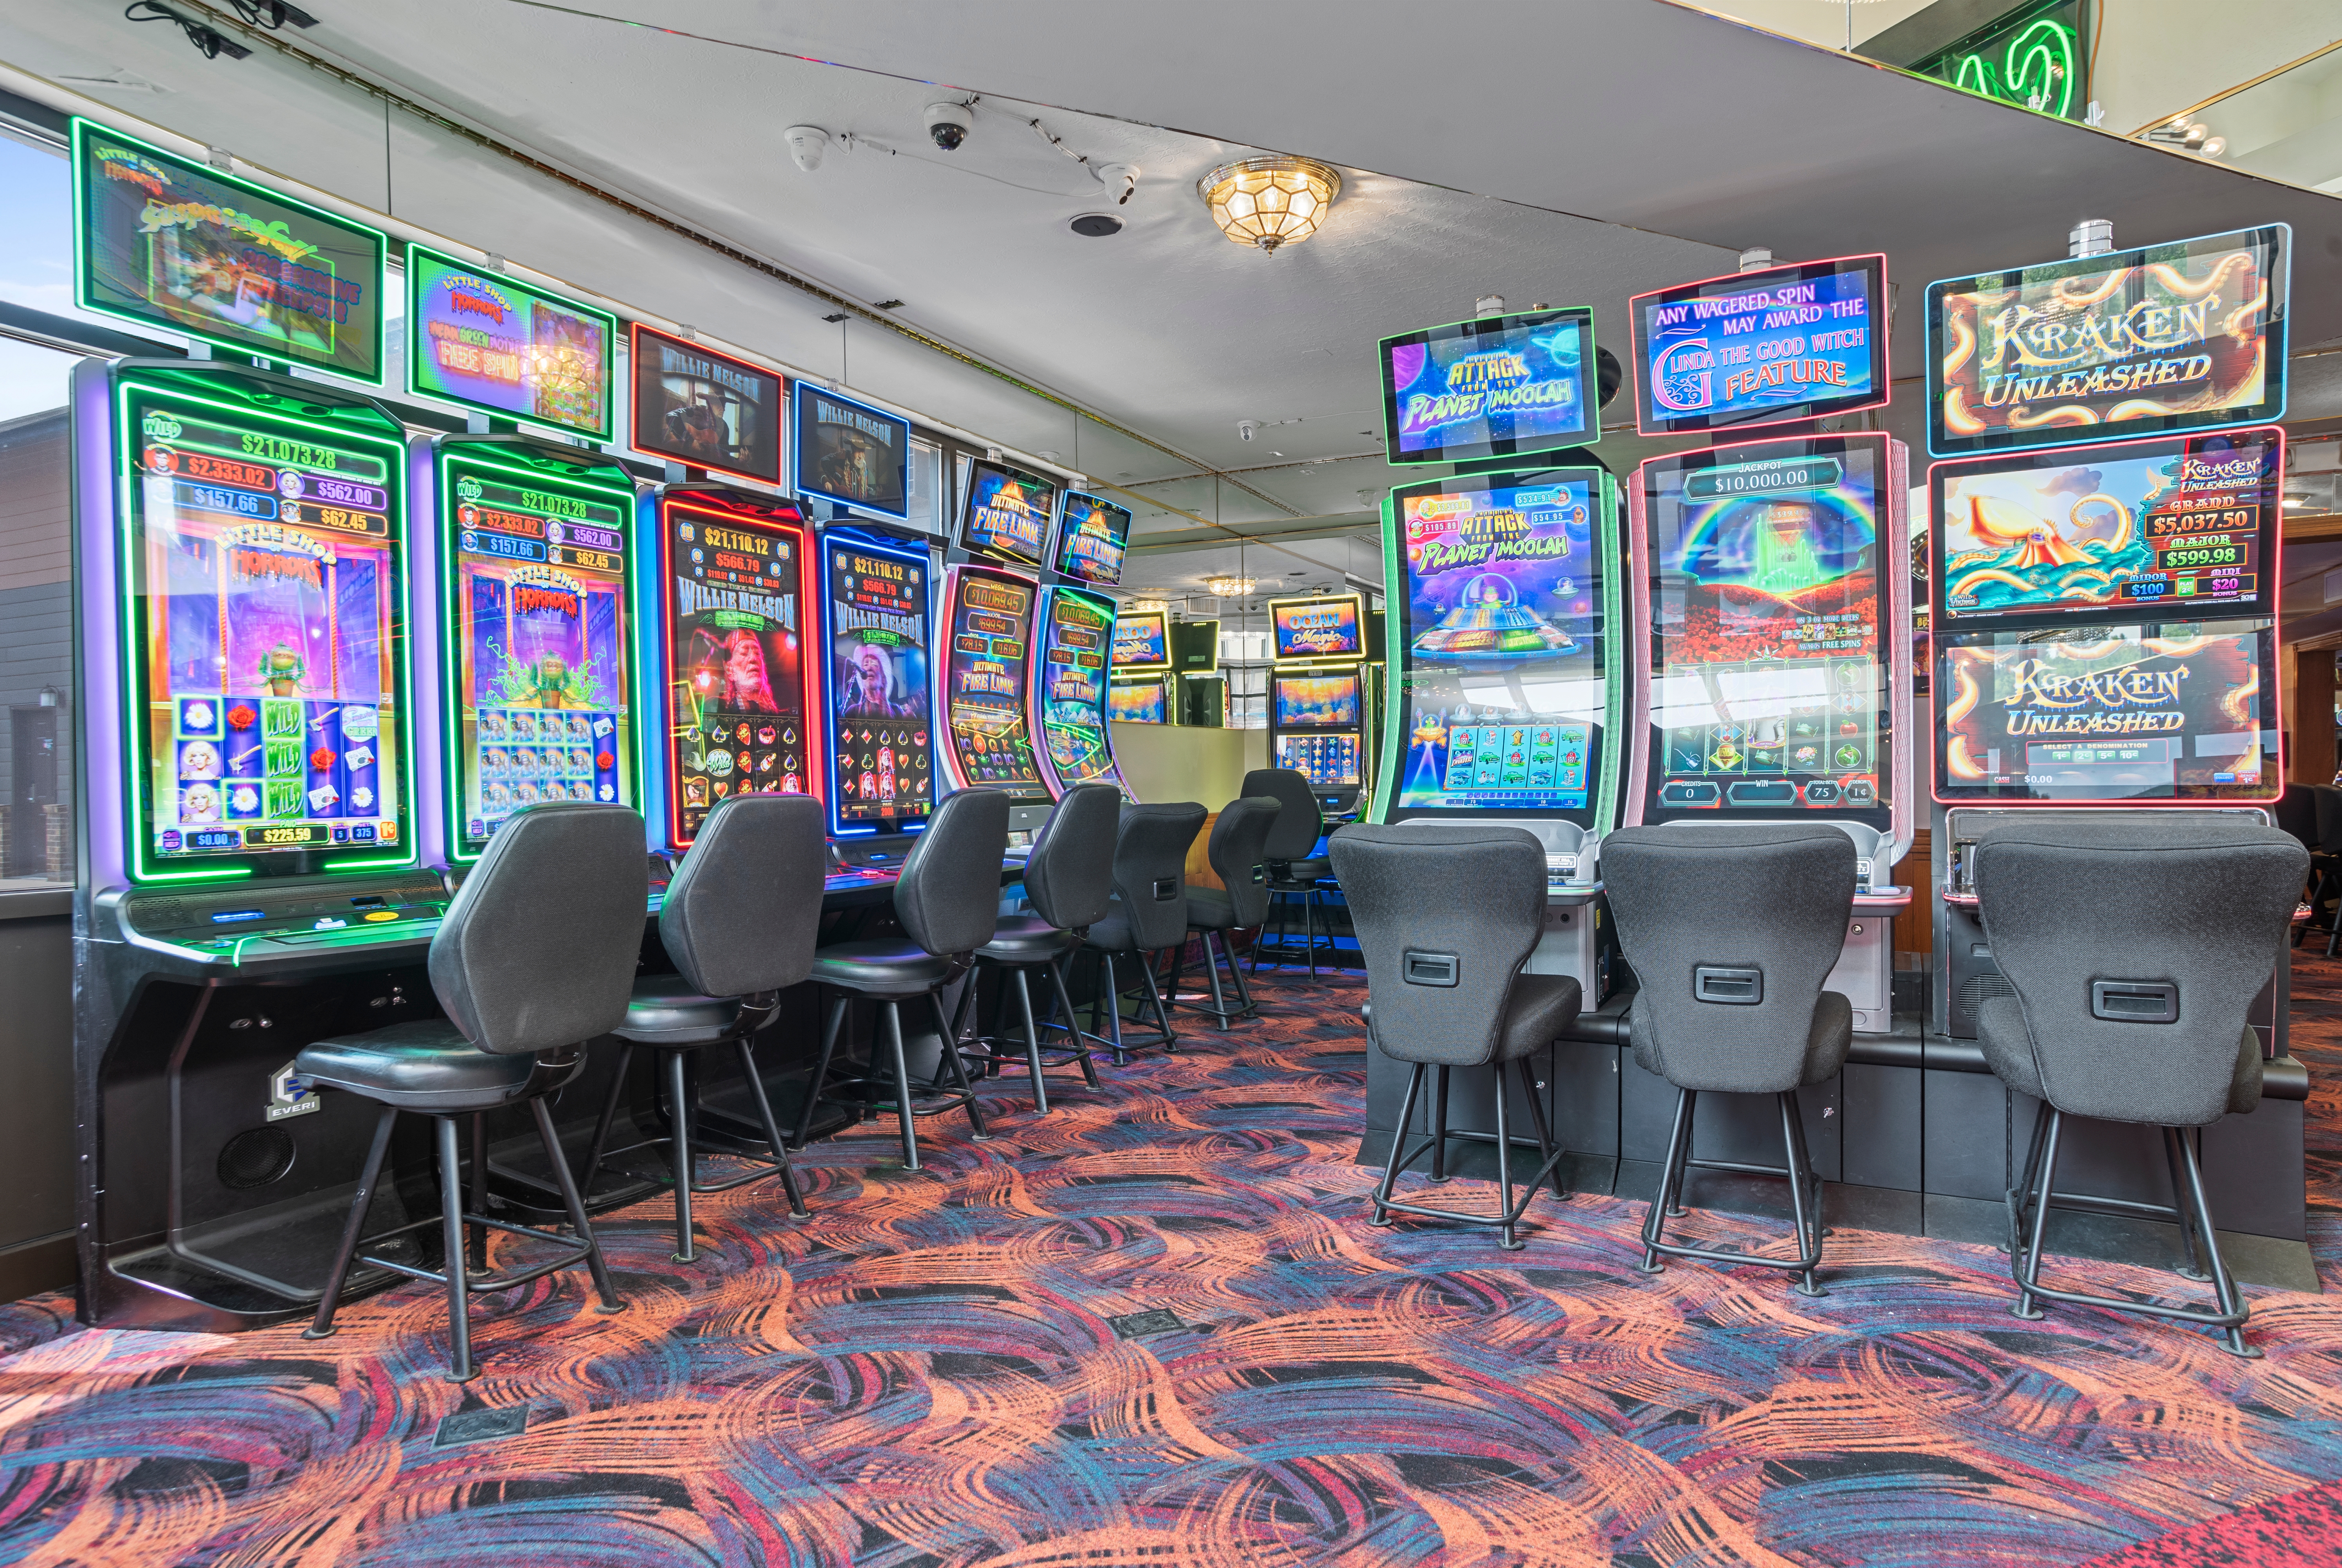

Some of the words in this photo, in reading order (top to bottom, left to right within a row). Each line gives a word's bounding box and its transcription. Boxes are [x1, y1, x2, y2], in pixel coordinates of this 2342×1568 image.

[452, 290, 504, 326] HORRORS
[484, 284, 512, 312] SHOP
[1656, 305, 1688, 326] ANY
[1694, 293, 1769, 320] WAGERED
[1777, 284, 1815, 305] SPIN
[1723, 316, 1756, 335] MAY
[1762, 306, 1822, 329] AWARD
[1830, 298, 1863, 317] THE
[1981, 292, 2223, 370] KRAKEN
[661, 345, 710, 378] WILLIE
[713, 365, 760, 405] NELSON
[1449, 356, 1528, 386] ATTACK
[1652, 338, 1715, 411] GLINDA
[1720, 345, 1750, 365] THE
[1756, 337, 1805, 360] GOOD
[1726, 360, 1847, 401] FEATURE
[1983, 355, 2212, 408] UNLEASHED
[1461, 383, 1486, 393] FROM
[1402, 392, 1485, 434] PLANET
[1490, 380, 1571, 408] MOOLAH
[816, 399, 853, 427] WILLIE
[856, 414, 892, 448] NELSON
[242, 434, 336, 470] $21,073.28
[189, 458, 265, 487] $2,333.02
[1738, 461, 1782, 473] JACKPOT
[2181, 458, 2261, 481] KRAKEN
[1715, 470, 1807, 493] $10,000.00
[2181, 477, 2258, 493] UNLEASHED
[194, 488, 258, 514] $157.66
[318, 481, 372, 505] $562.00
[1518, 494, 1551, 504] $534.91
[2170, 496, 2235, 512] GRAND
[522, 492, 586, 517] $21,073.28
[990, 494, 1030, 517] ULTIMATE
[1437, 502, 1469, 511] $2,569.81
[321, 509, 367, 531] $62.45
[487, 514, 538, 534] $2,333.02
[972, 506, 1007, 532] FIRE
[1009, 512, 1039, 545] LINK
[1425, 522, 1457, 532] $105.89
[1461, 513, 1530, 535] ATTACK
[1533, 512, 1563, 522] $54.95
[2155, 511, 2247, 534] $5,037.50
[268, 544, 281, 552] OF
[289, 529, 337, 566] SHOP
[491, 539, 533, 557] $157.66
[574, 528, 612, 547] $562.00
[705, 527, 768, 555] $21,110.12
[2170, 535, 2231, 548] MAJOR
[576, 552, 608, 568] $62.45
[716, 553, 759, 572] $566.79
[1418, 542, 1491, 575] PLANET
[1497, 536, 1568, 556] MOOLAH
[2167, 548, 2235, 567] $599.98
[231, 548, 324, 591] HORRORS
[708, 569, 727, 580] $119.92
[739, 574, 755, 584] $51.43
[854, 557, 903, 580] $21,110.12
[2129, 573, 2167, 582] MINOR
[2210, 568, 2241, 577] MINI
[554, 570, 587, 598] SHOP
[764, 578, 779, 588] $30.83
[863, 579, 896, 595] $566.79
[2132, 583, 2164, 596] $100
[2212, 579, 2238, 590] $20
[514, 587, 578, 621] HORRORS
[677, 575, 737, 617] WILLIE
[738, 591, 795, 632] NELSON
[834, 599, 879, 636] WILLIE
[881, 612, 924, 647] NELSON
[1289, 613, 1341, 629] OCEAN
[1293, 629, 1341, 645] Magic
[973, 661, 1004, 674] ULTIMATE
[1062, 672, 1088, 684] ULTIMATE
[962, 673, 988, 692] FIRE
[990, 675, 1014, 696] LINK
[1052, 683, 1074, 699] FIRE
[1076, 683, 1095, 703] LINK
[2004, 658, 2190, 710] KRAKEN
[2007, 710, 2184, 735] UNLEASHED
[1011, 767, 1021, 779] A
[2025, 775, 2052, 784] $0.00
[1815, 788, 1829, 797] 75
[264, 827, 311, 843] $225.59
[357, 828, 371, 838] 375
[272, 1101, 315, 1117] EVERI
